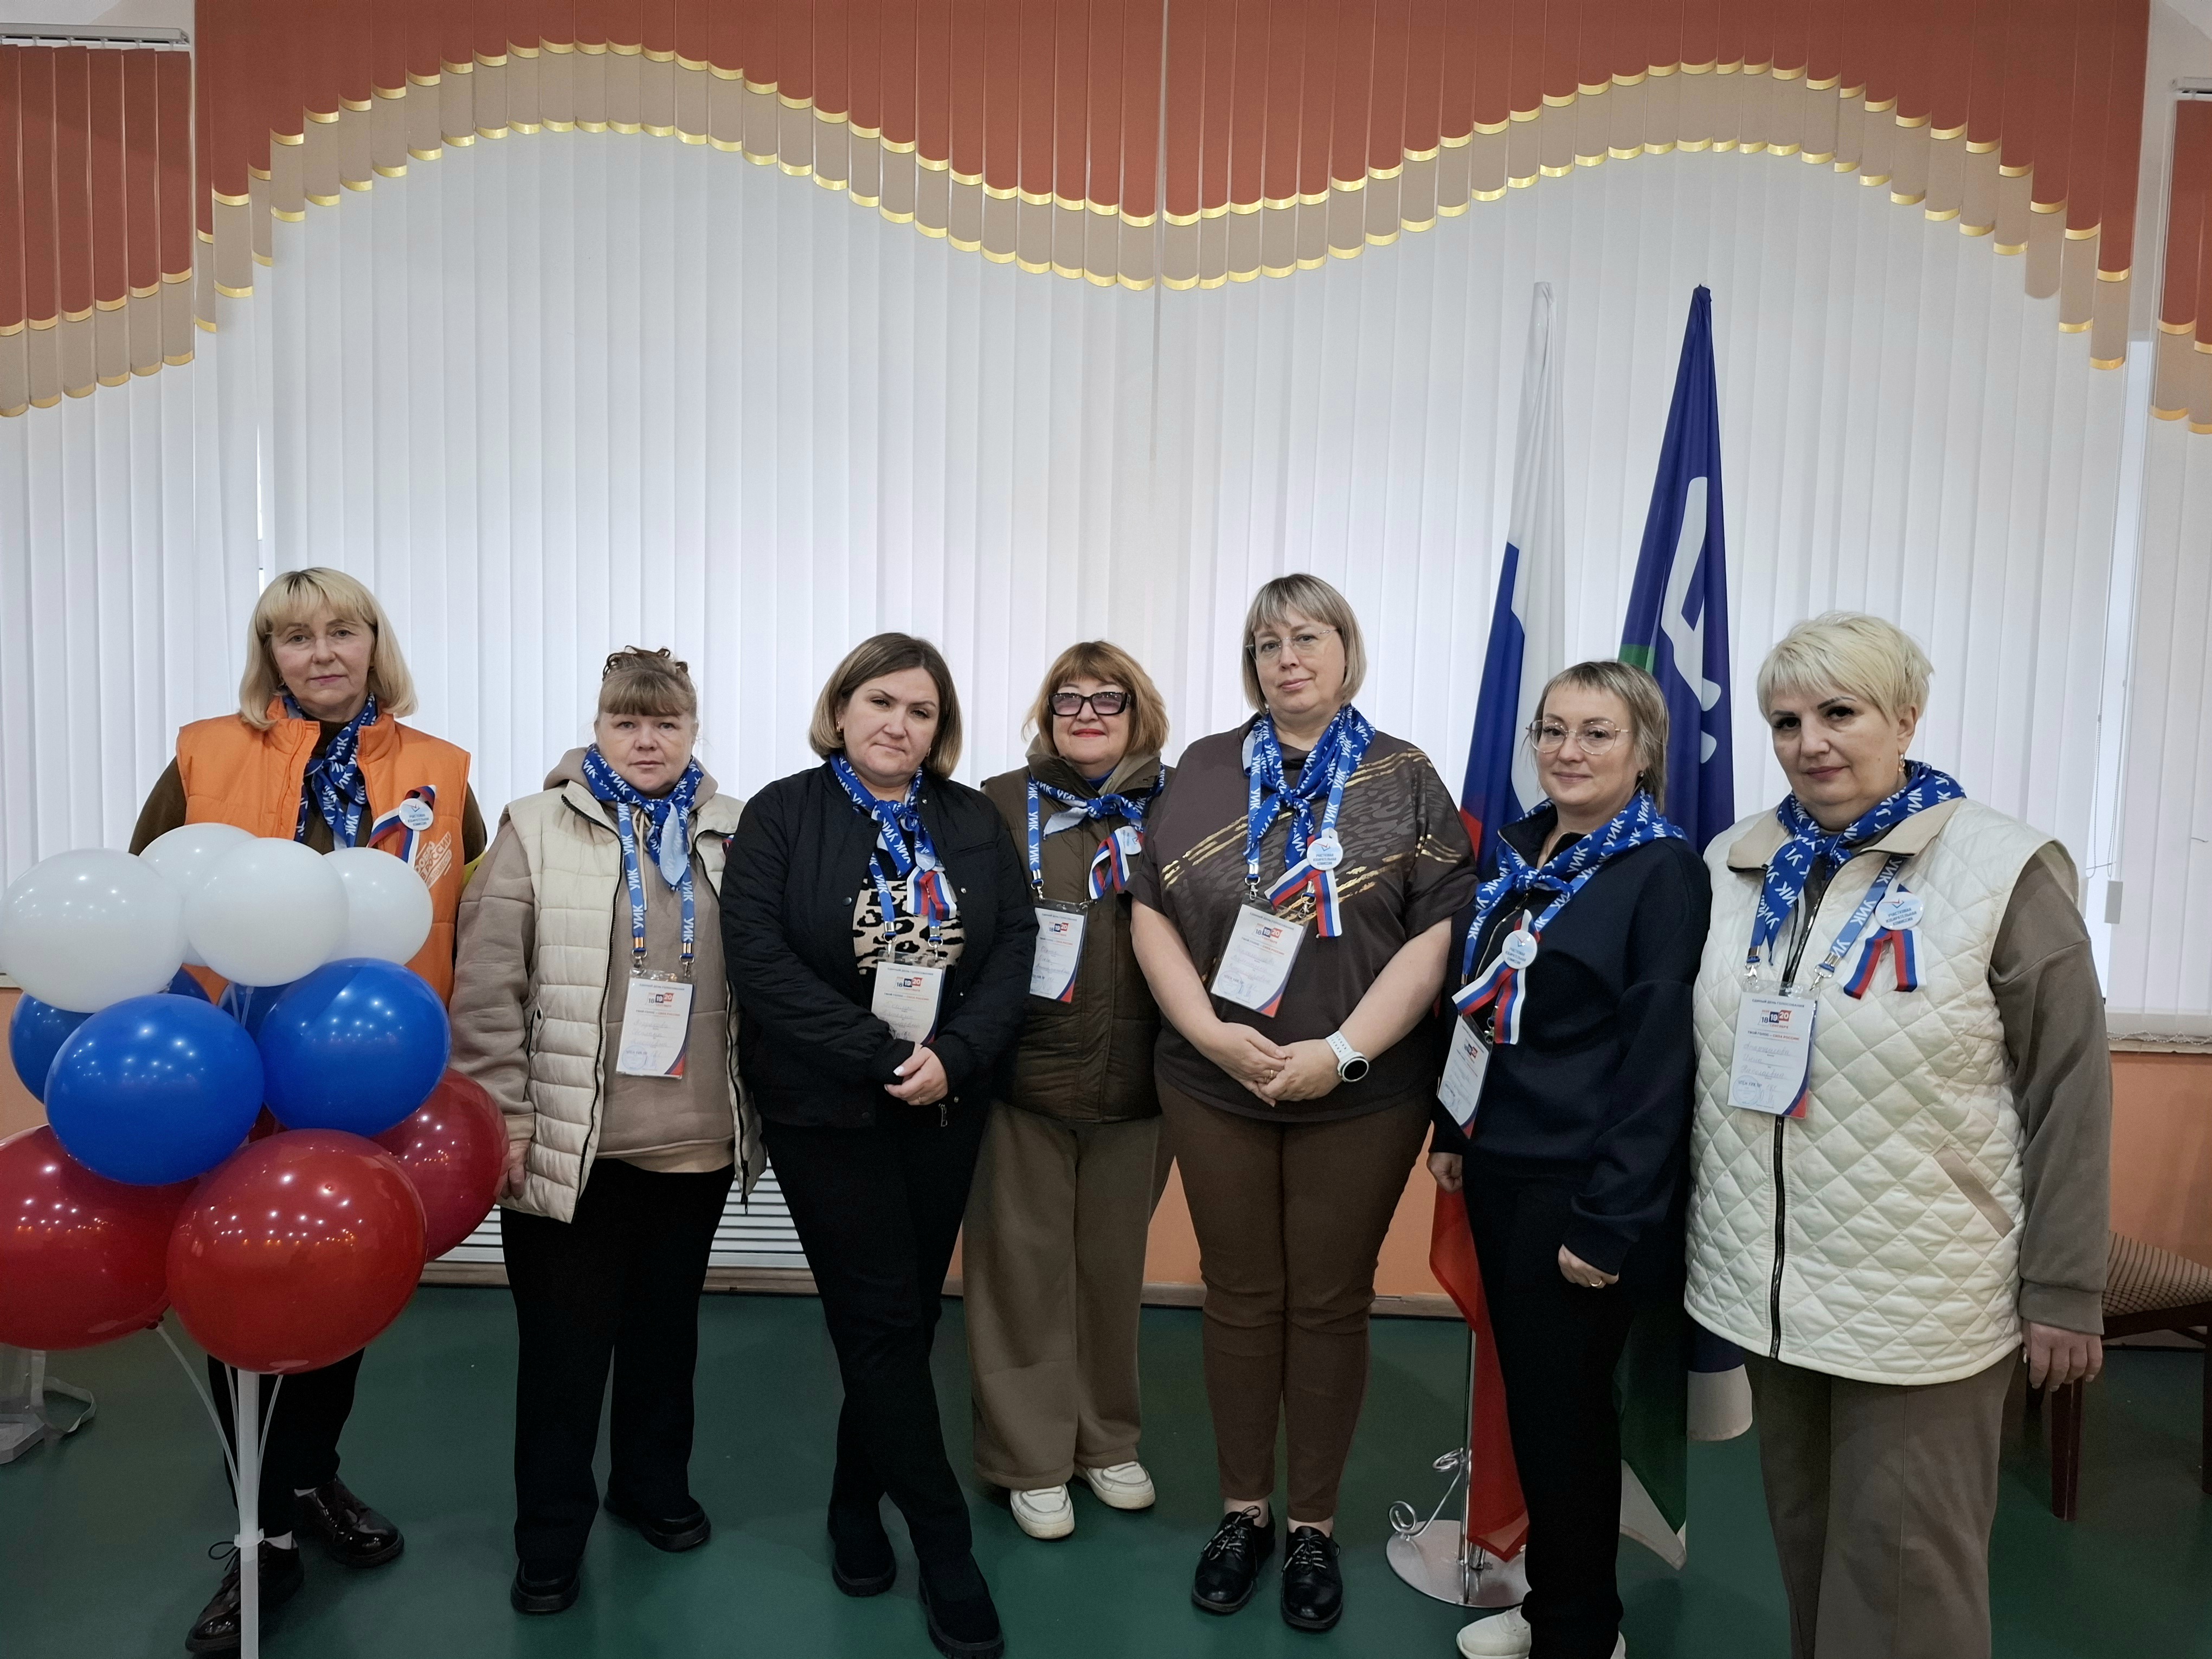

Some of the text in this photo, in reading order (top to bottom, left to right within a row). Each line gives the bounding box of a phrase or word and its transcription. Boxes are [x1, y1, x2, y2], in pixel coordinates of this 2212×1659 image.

[1353, 721, 1371, 745] УИК
[1251, 754, 1261, 776] УИК
[334, 771, 353, 790] ИК
[608, 770, 631, 796] УИК
[1332, 767, 1347, 790] УИК
[1028, 782, 1038, 800] УИК
[1250, 788, 1261, 810] УИК
[618, 802, 630, 822] УИК
[1028, 811, 1038, 831] УИК
[1323, 801, 1339, 824] УИК
[1637, 797, 1650, 825] УИК
[345, 814, 359, 836] УИК
[1603, 818, 1625, 847] УИК
[1651, 822, 1666, 839] ИК
[426, 832, 452, 873] РОССИИ
[622, 834, 635, 856] УИК
[1030, 843, 1039, 865] УИК
[1566, 845, 1589, 873] УИК
[627, 867, 640, 891] УИК
[1876, 859, 1903, 884] УИК
[682, 880, 694, 902] УИК
[873, 874, 889, 893] УИК
[1481, 878, 1503, 895] ИК
[1774, 880, 1797, 908] ИК
[632, 904, 644, 929] УИК
[1850, 899, 1877, 926] УИК
[683, 917, 695, 942] УИК
[1467, 916, 1487, 940] УИК
[1832, 939, 1850, 956] УИ
